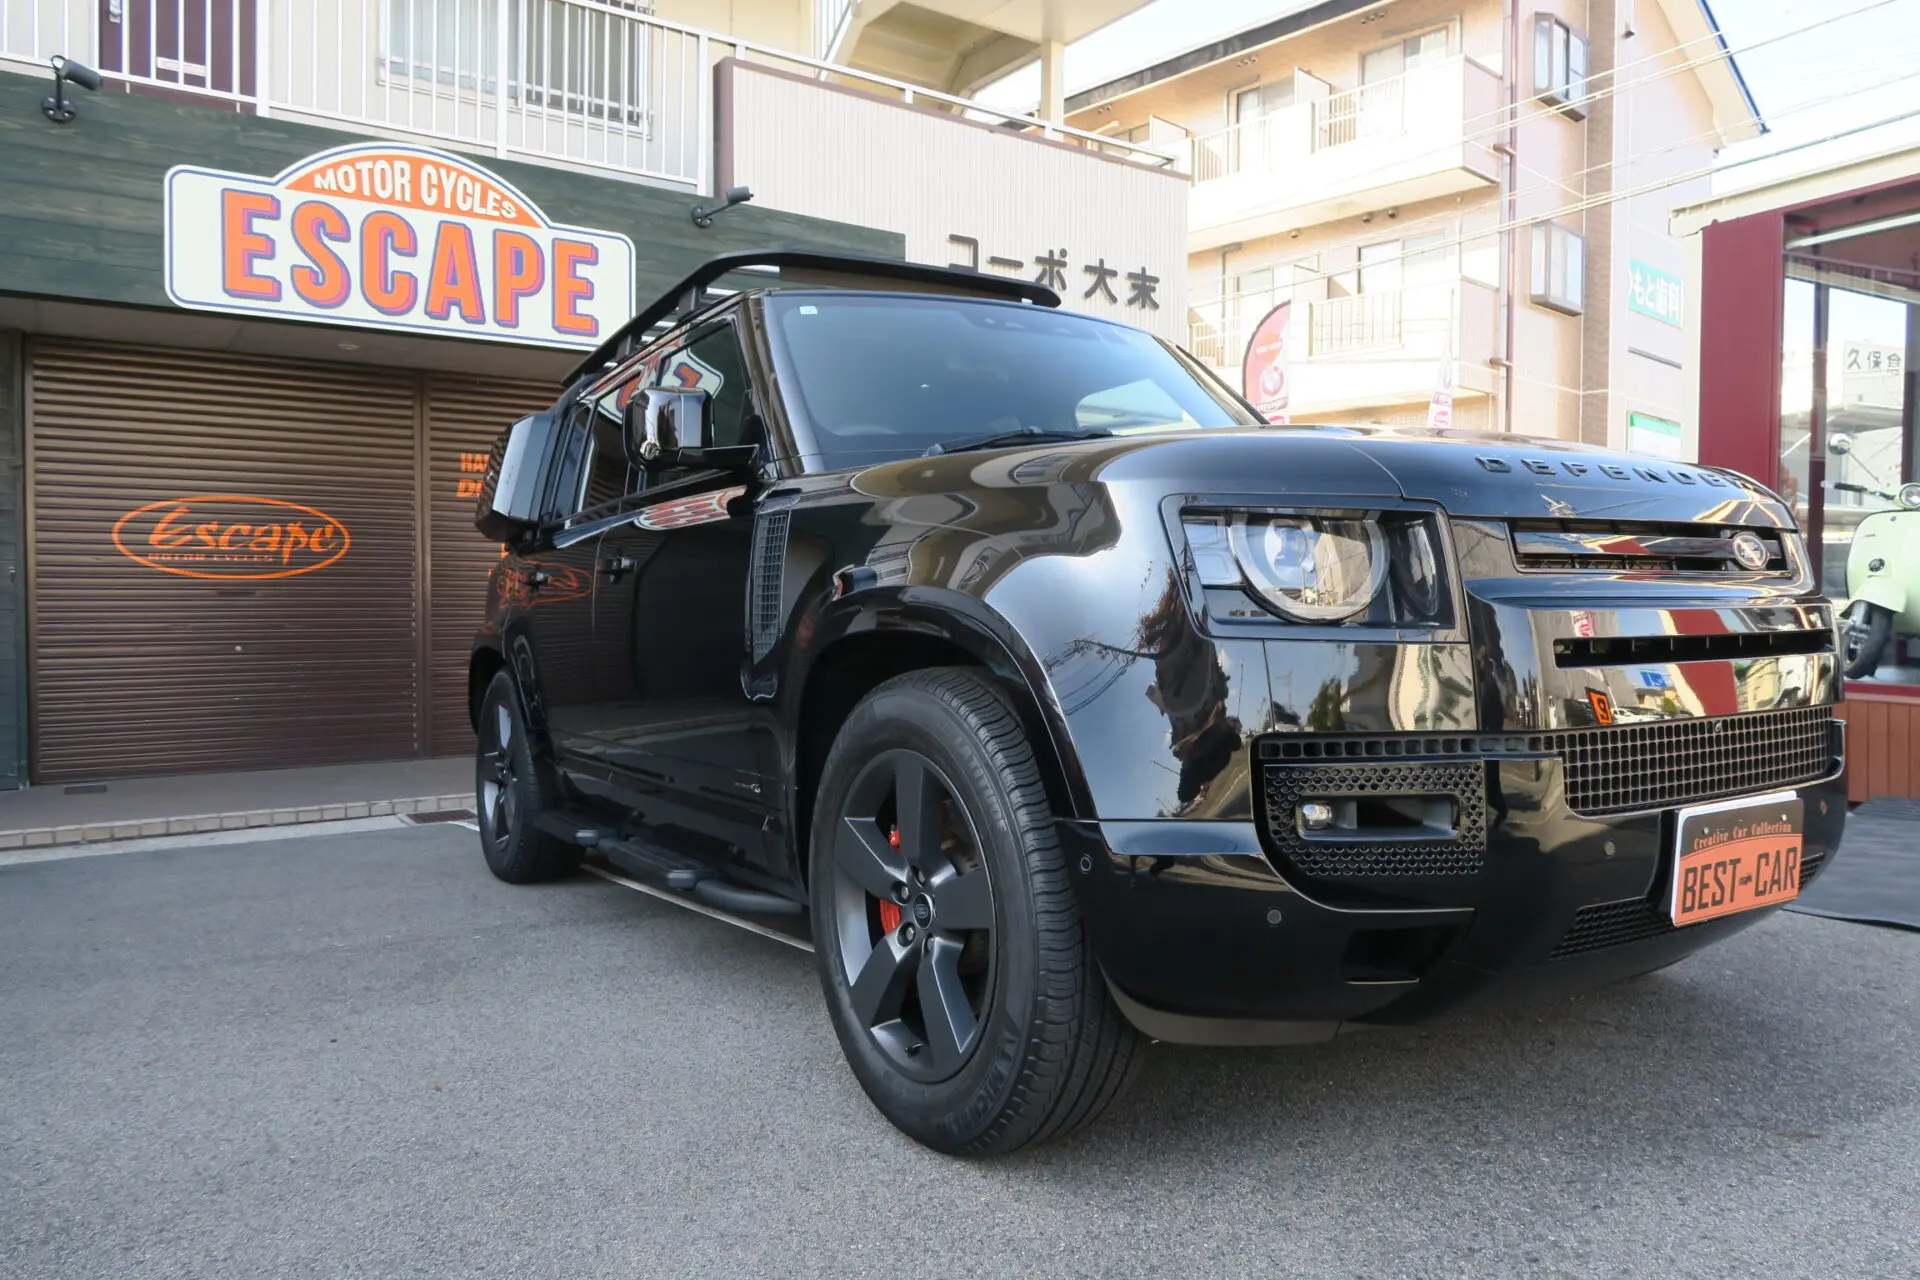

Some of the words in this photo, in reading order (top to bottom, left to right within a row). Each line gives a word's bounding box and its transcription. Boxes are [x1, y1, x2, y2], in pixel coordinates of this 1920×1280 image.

[313, 159, 411, 204] MOTOR
[419, 163, 518, 220] CYCLES
[221, 187, 599, 337] ESCAPE
[948, 233, 1160, 310] コーポ大末
[1474, 456, 1752, 490] DEFENDER
[147, 553, 205, 562] MOTOR
[212, 554, 273, 563] CYCLES
[148, 506, 338, 564] Escape
[1694, 831, 1729, 850] Creative
[1733, 827, 1747, 840] Car
[1751, 821, 1793, 836] Collection
[1681, 858, 1742, 914] BEST
[1754, 846, 1798, 898] CAR
